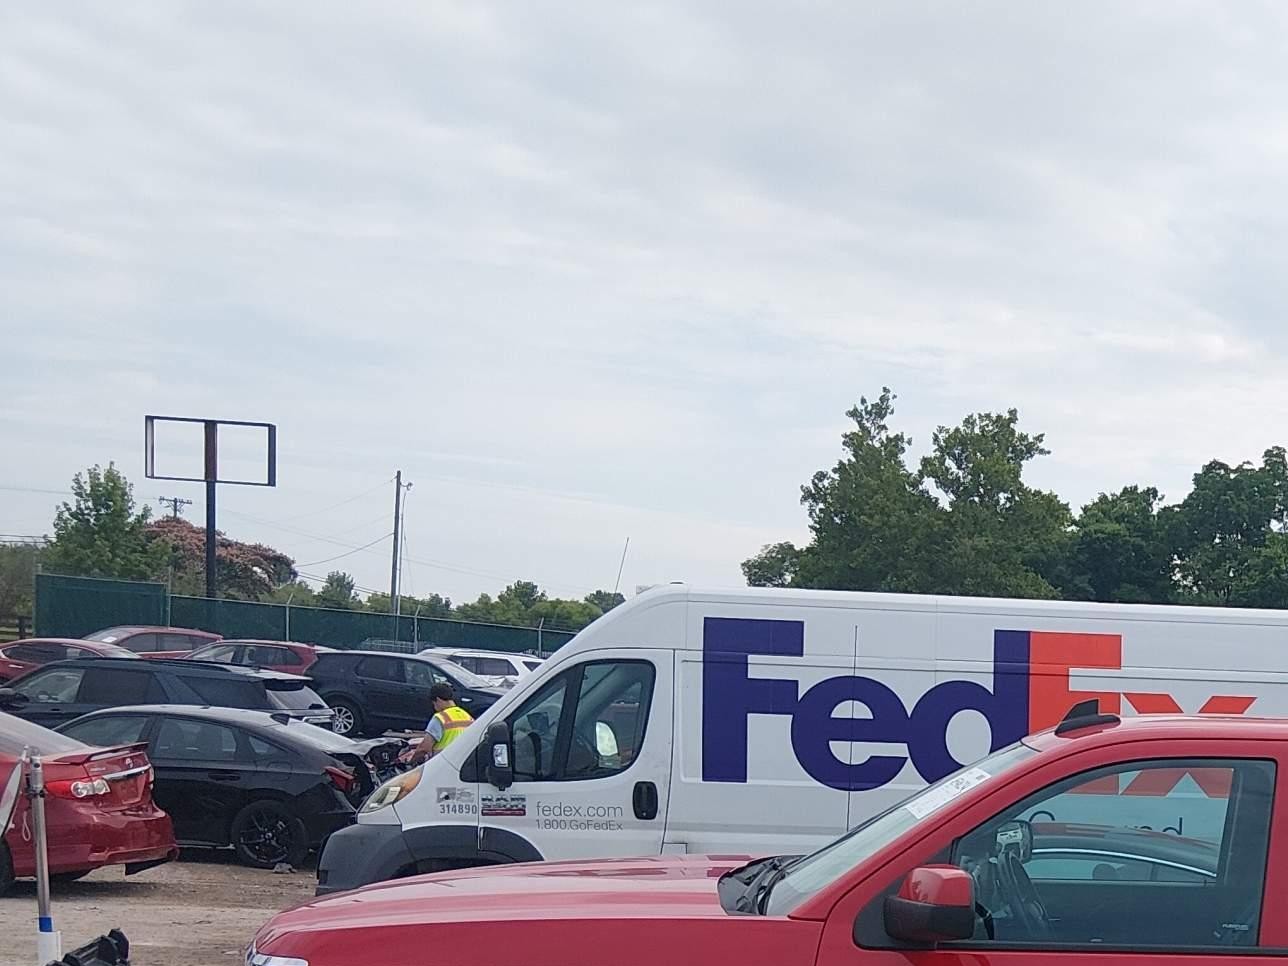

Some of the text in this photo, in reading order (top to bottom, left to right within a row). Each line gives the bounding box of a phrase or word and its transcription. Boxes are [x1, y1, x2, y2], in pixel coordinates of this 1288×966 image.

[440, 804, 478, 814] 314890
[536, 801, 623, 818] fedex.com
[535, 819, 623, 831] 1.800.GoFedEx
